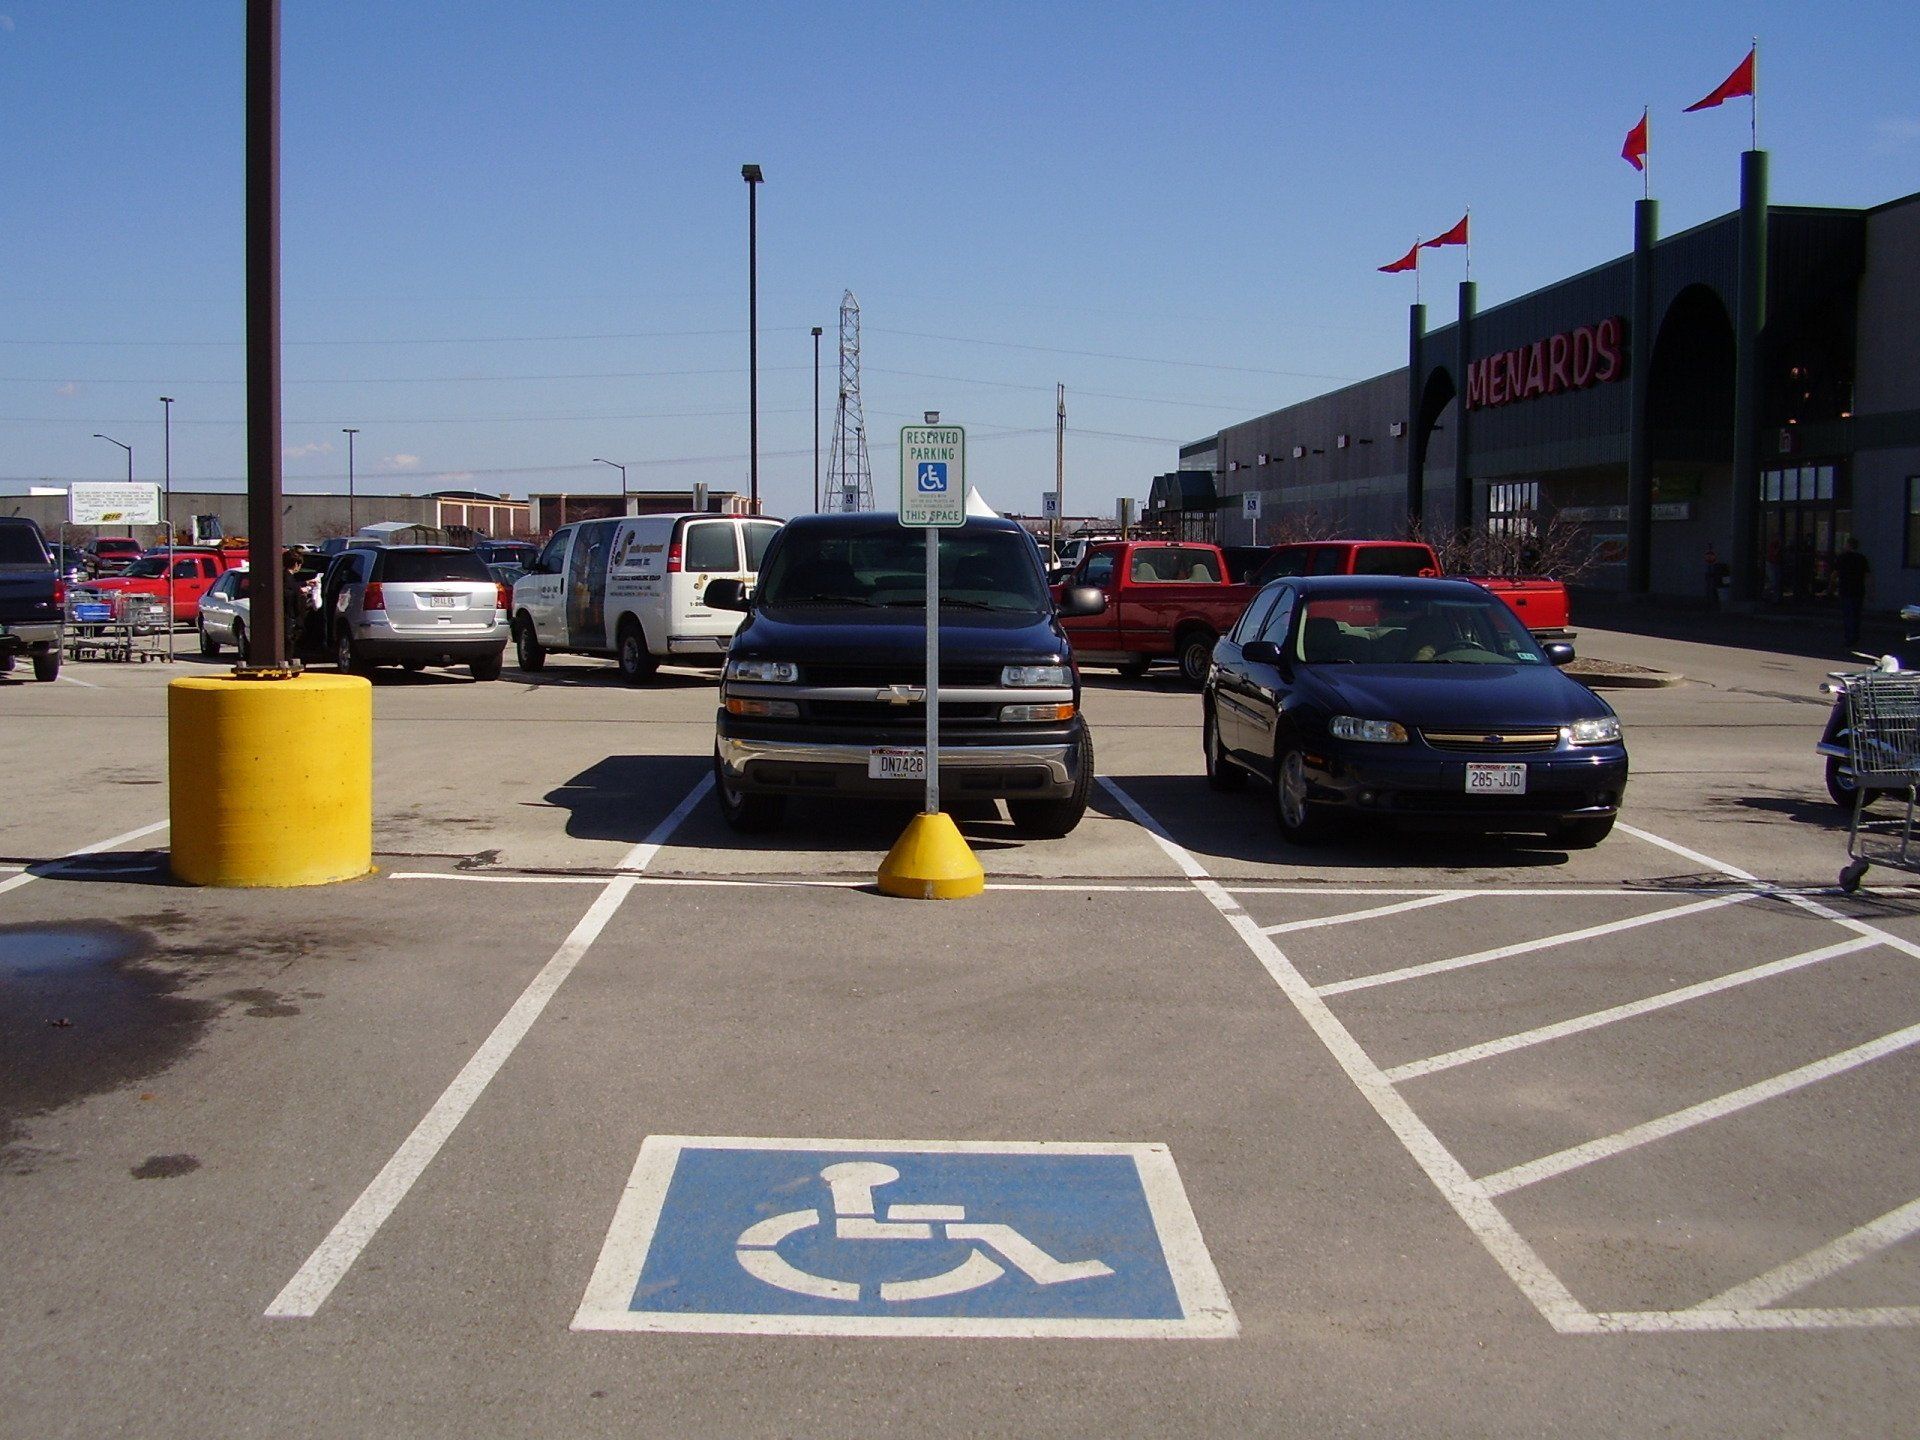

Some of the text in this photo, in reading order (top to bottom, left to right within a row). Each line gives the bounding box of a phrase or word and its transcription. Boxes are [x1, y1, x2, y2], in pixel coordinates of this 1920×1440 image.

[1466, 315, 1623, 410] MENARDS
[907, 431, 958, 444] RESERVED
[910, 447, 955, 460] PARKING
[905, 510, 959, 521] THIS SPACE
[881, 757, 924, 772] DN7428
[1472, 772, 1521, 787] 285-JJD
